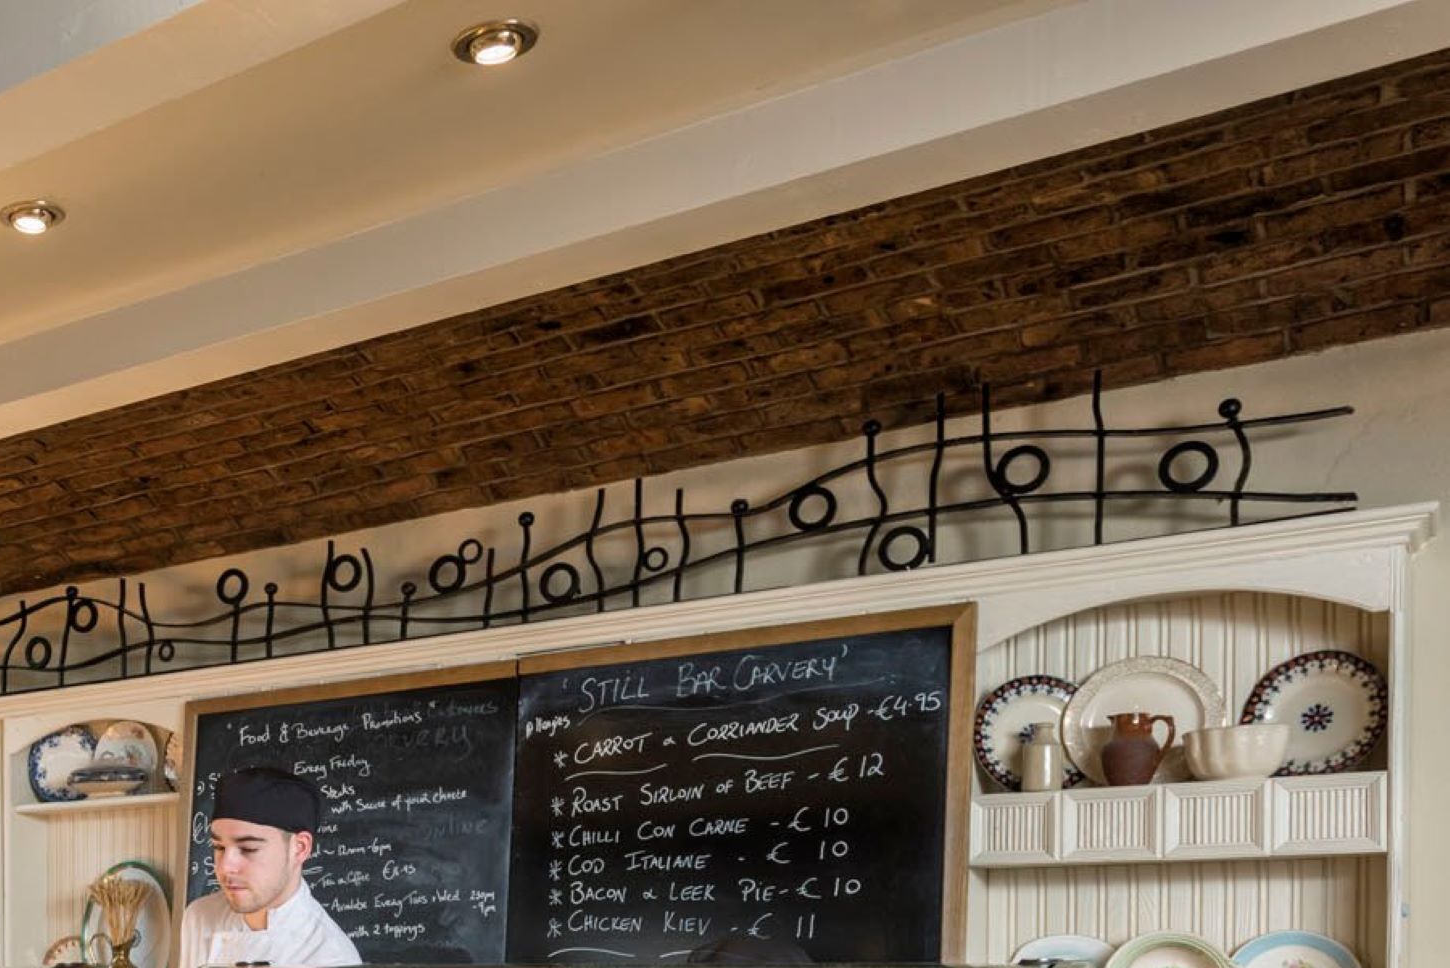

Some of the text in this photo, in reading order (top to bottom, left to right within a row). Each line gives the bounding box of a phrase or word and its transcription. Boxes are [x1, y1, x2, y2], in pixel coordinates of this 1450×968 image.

[677, 662, 726, 698] BAR
[240, 724, 270, 746] Food
[574, 732, 653, 764] CARROT
[571, 786, 624, 817] ROAST
[640, 783, 705, 805] SIRLOIN
[744, 769, 795, 793] BEEF
[569, 825, 620, 846] CHILLI
[637, 821, 675, 840] CON
[689, 817, 749, 836] CARNE
[568, 855, 605, 875] COD
[624, 850, 712, 870] ITALIANE
[570, 880, 627, 904] BACON
[669, 882, 715, 901] LEEK
[568, 909, 644, 932] CHICKEN
[663, 910, 711, 935] KIEV
